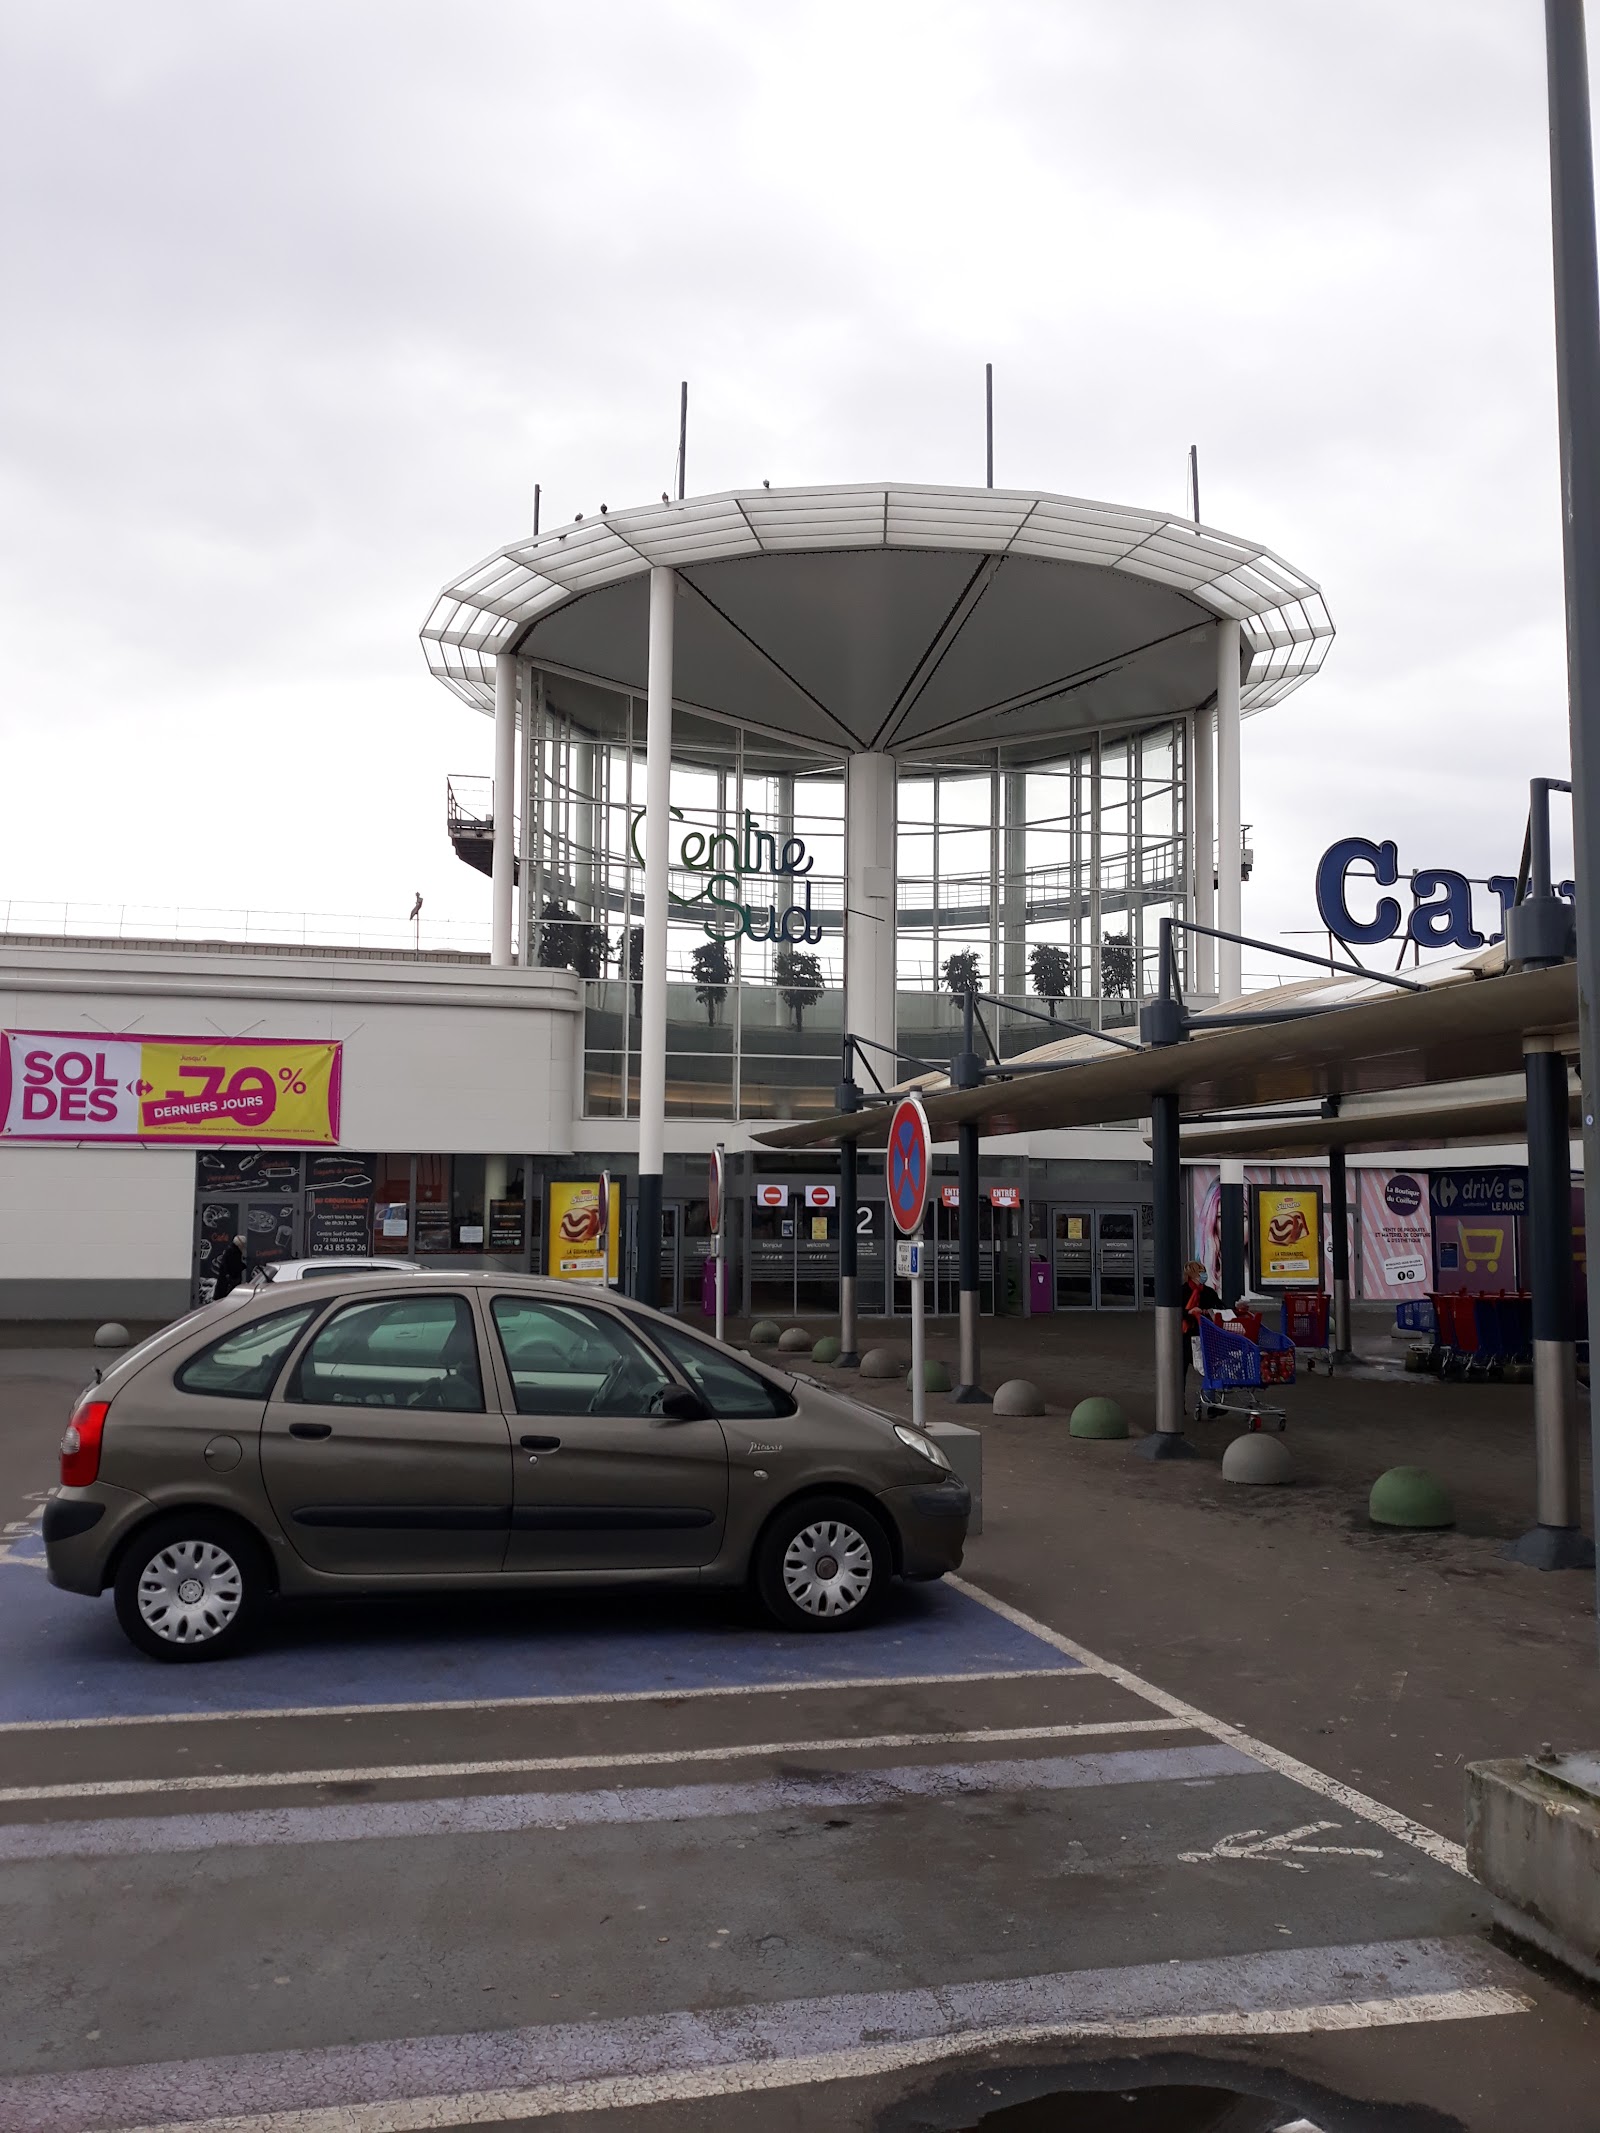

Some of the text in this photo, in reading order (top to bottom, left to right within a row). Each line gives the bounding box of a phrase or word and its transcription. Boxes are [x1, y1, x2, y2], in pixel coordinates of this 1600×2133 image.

[703, 874, 822, 944] Sud
[23, 1050, 118, 1087] SOL
[22, 1086, 118, 1122] DES
[153, 1095, 264, 1118] DERNIERS JOURS
[992, 1187, 1017, 1197] ENTRÉE
[1394, 1187, 1421, 1197] Boutique
[1462, 1175, 1505, 1200] drive
[1395, 1196, 1419, 1205] Coiffeur
[1491, 1202, 1501, 1211] LE
[1502, 1201, 1525, 1211] MANS
[855, 1206, 874, 1234] 2
[762, 1242, 783, 1250] bonjour
